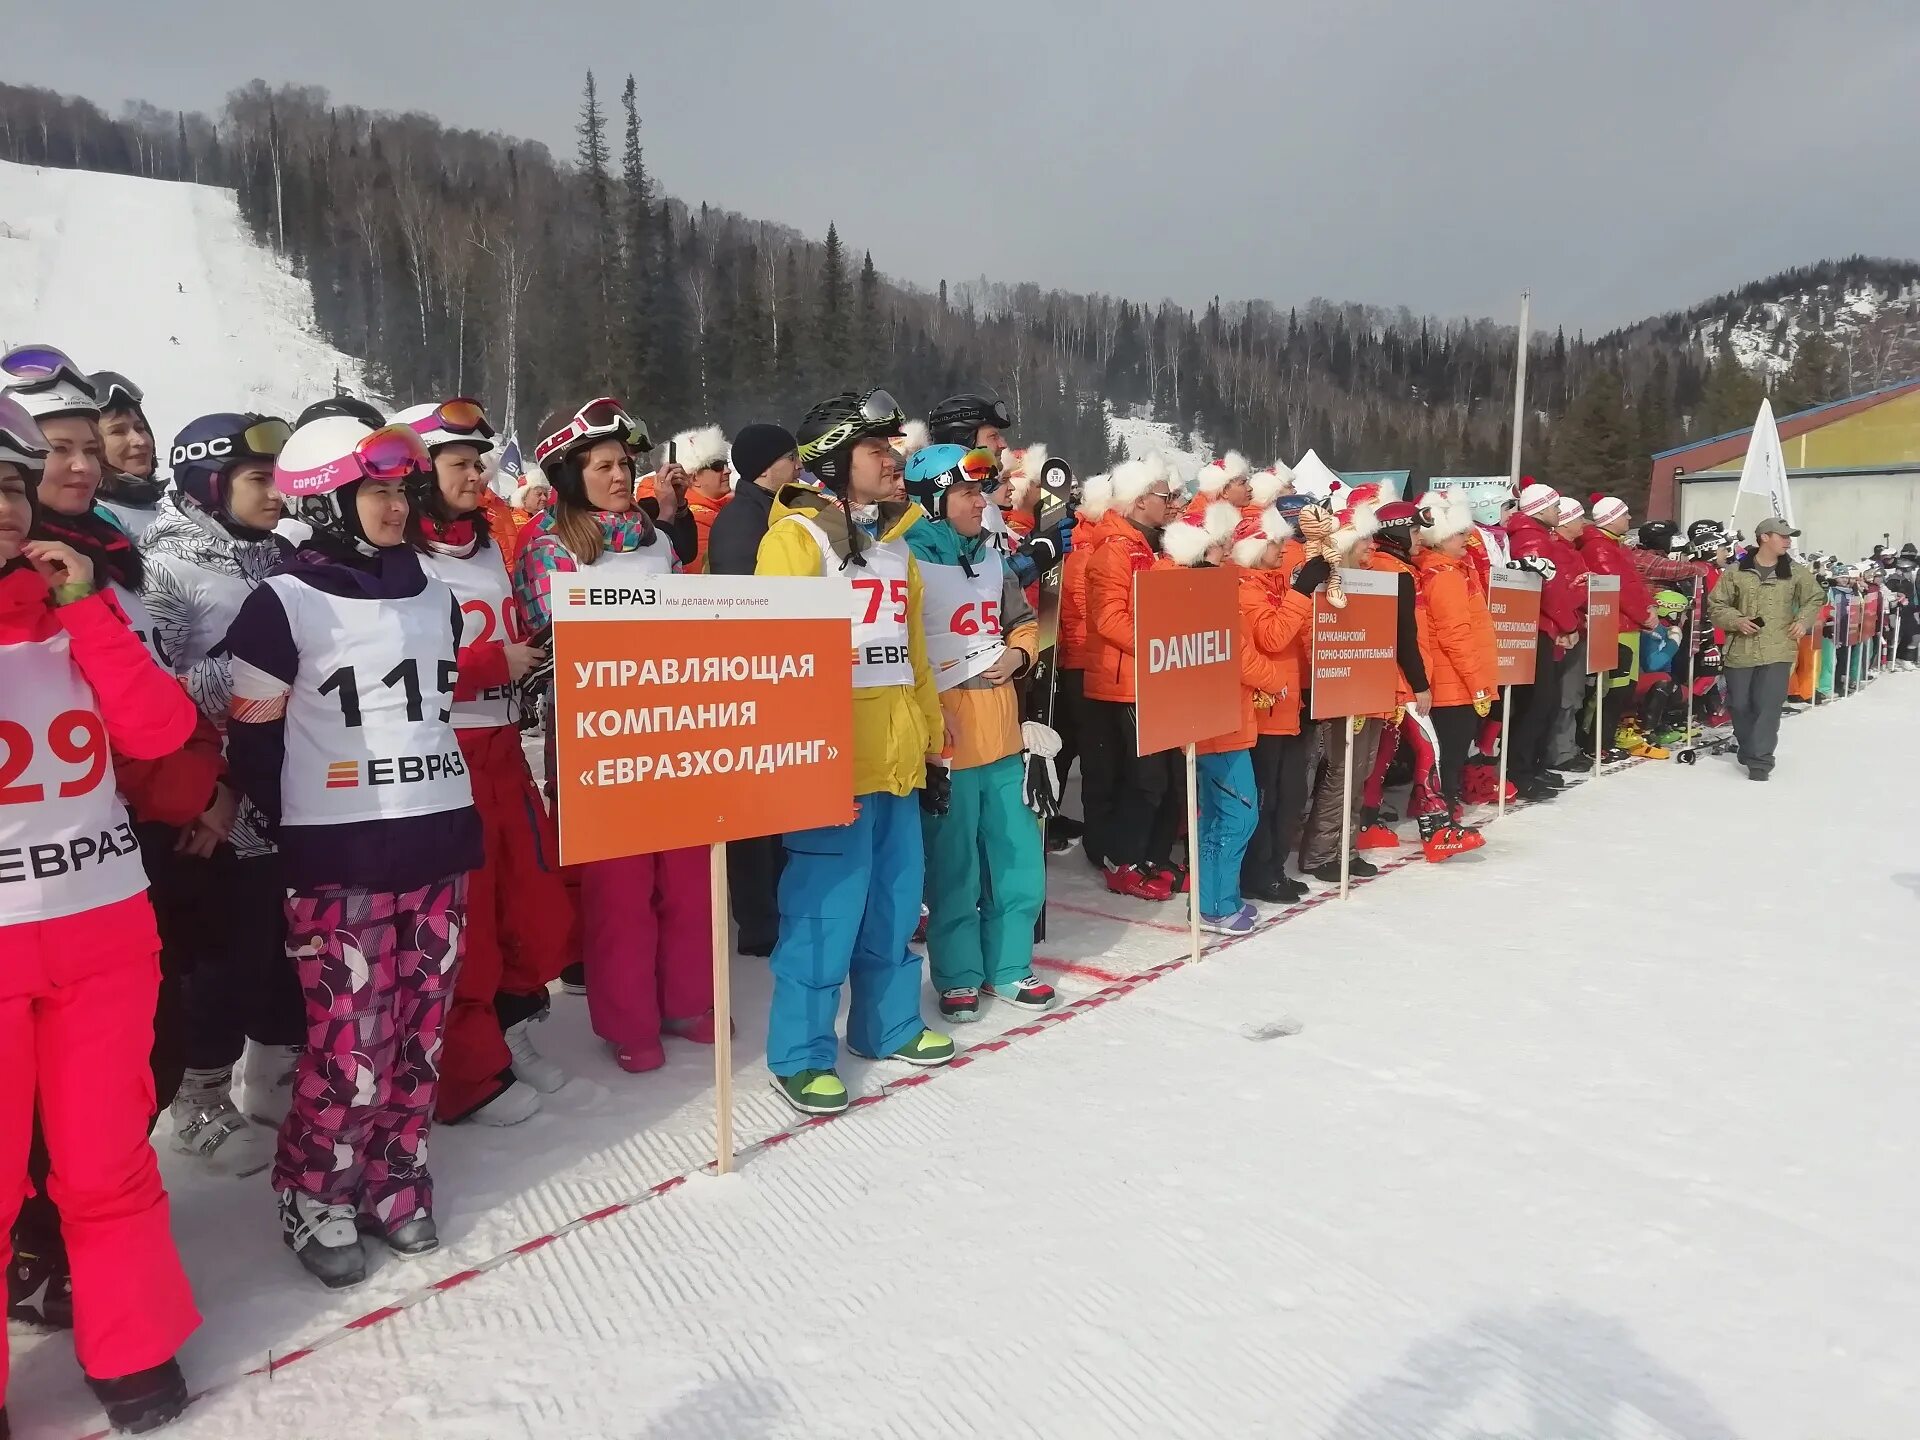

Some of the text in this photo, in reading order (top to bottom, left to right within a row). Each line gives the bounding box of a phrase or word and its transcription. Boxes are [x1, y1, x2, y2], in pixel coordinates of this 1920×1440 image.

[172, 437, 233, 465] POC
[292, 470, 331, 489] COPOZZ
[1377, 516, 1413, 529] uvex
[1049, 576, 1059, 587] 4
[589, 588, 769, 607] ЕВРАЗ мы делаем мир сильнее
[852, 579, 908, 624] 75
[949, 601, 1001, 636] 65
[1318, 612, 1337, 624] ЕВРАЗ
[1317, 628, 1366, 642] КАЧКАНАРСКИЙ
[865, 645, 909, 665] ЕВР
[1149, 628, 1231, 674] DANIELI
[1317, 646, 1394, 660] ГОРНО-ОБОГАТИТЕЛЬНЫЙ
[573, 653, 815, 689] УПРАВЛЯЮЩАЯ
[1317, 666, 1352, 679] КОМБИНАТ
[576, 701, 757, 739] КОМПАНИЯ
[0, 709, 108, 806] 29
[367, 751, 466, 786] ЕВРАЗ
[578, 739, 839, 787] «ЕВРАЗХОЛДИНГ»
[0, 822, 139, 884] ЕВРАЗ
